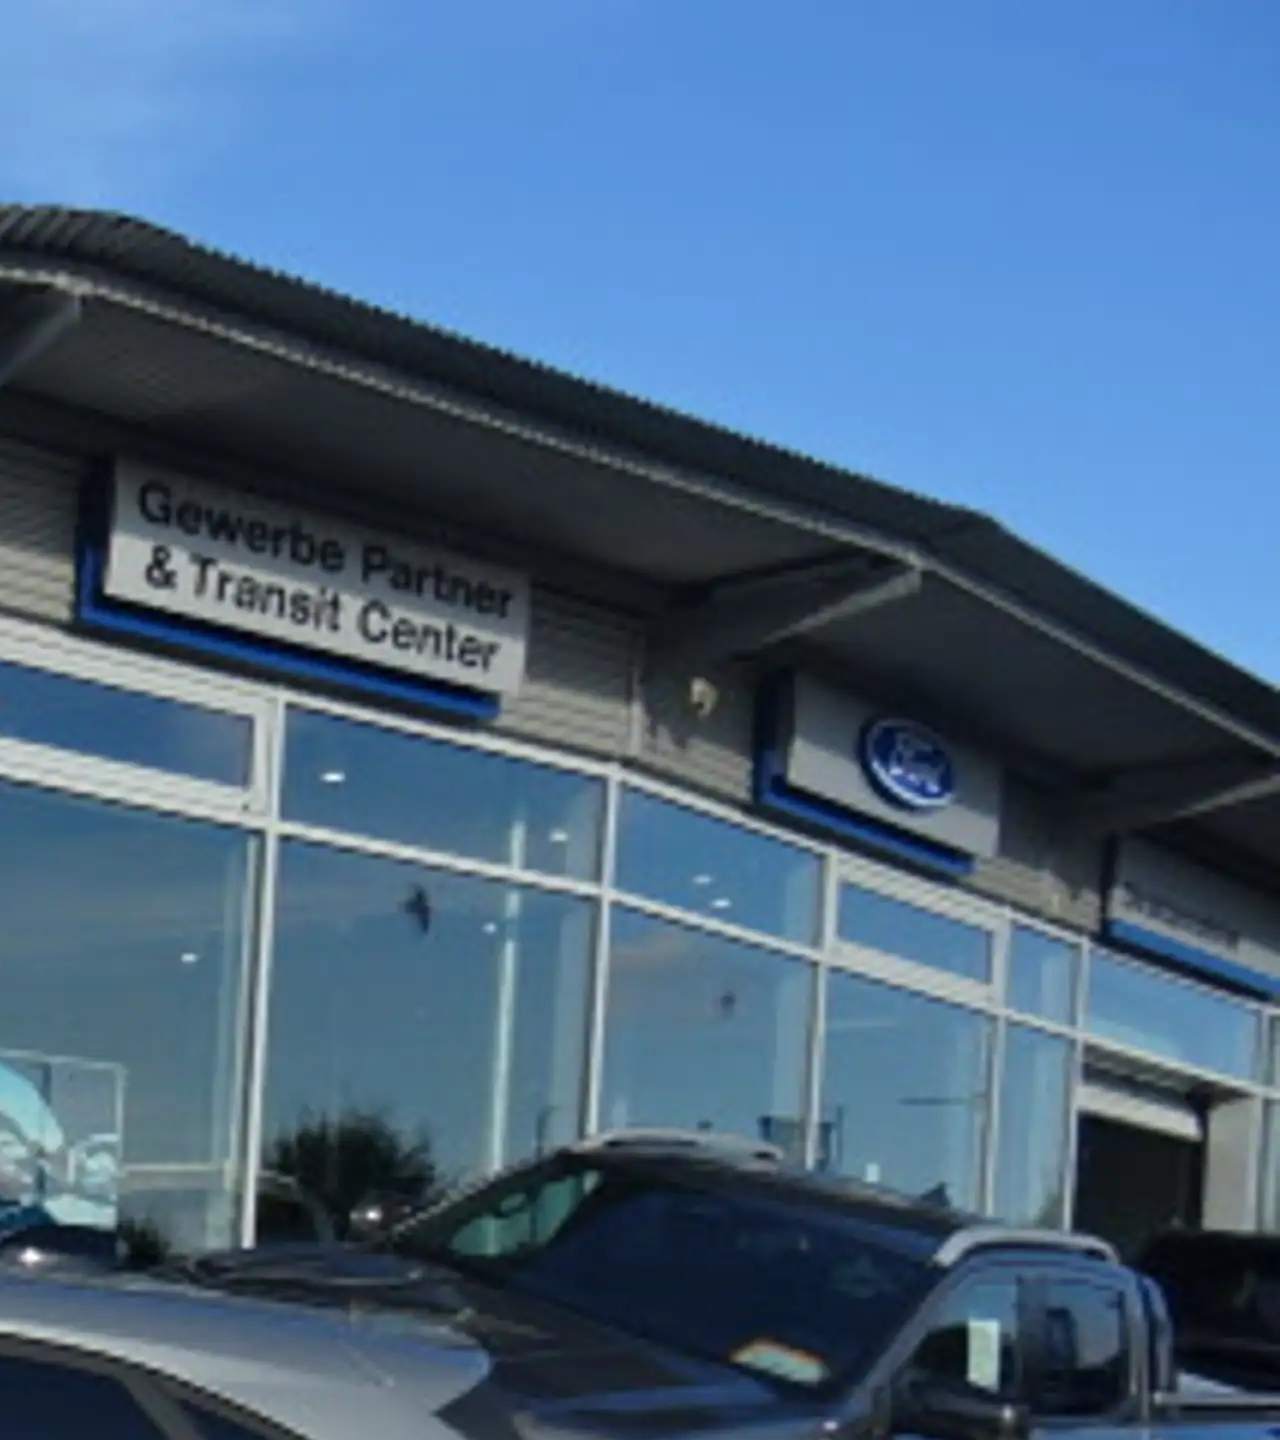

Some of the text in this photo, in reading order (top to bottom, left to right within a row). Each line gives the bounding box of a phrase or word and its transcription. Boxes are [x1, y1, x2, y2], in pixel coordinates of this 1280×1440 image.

[137, 479, 512, 620] Gewerbe Partner
[144, 545, 502, 674] & Transit Center
